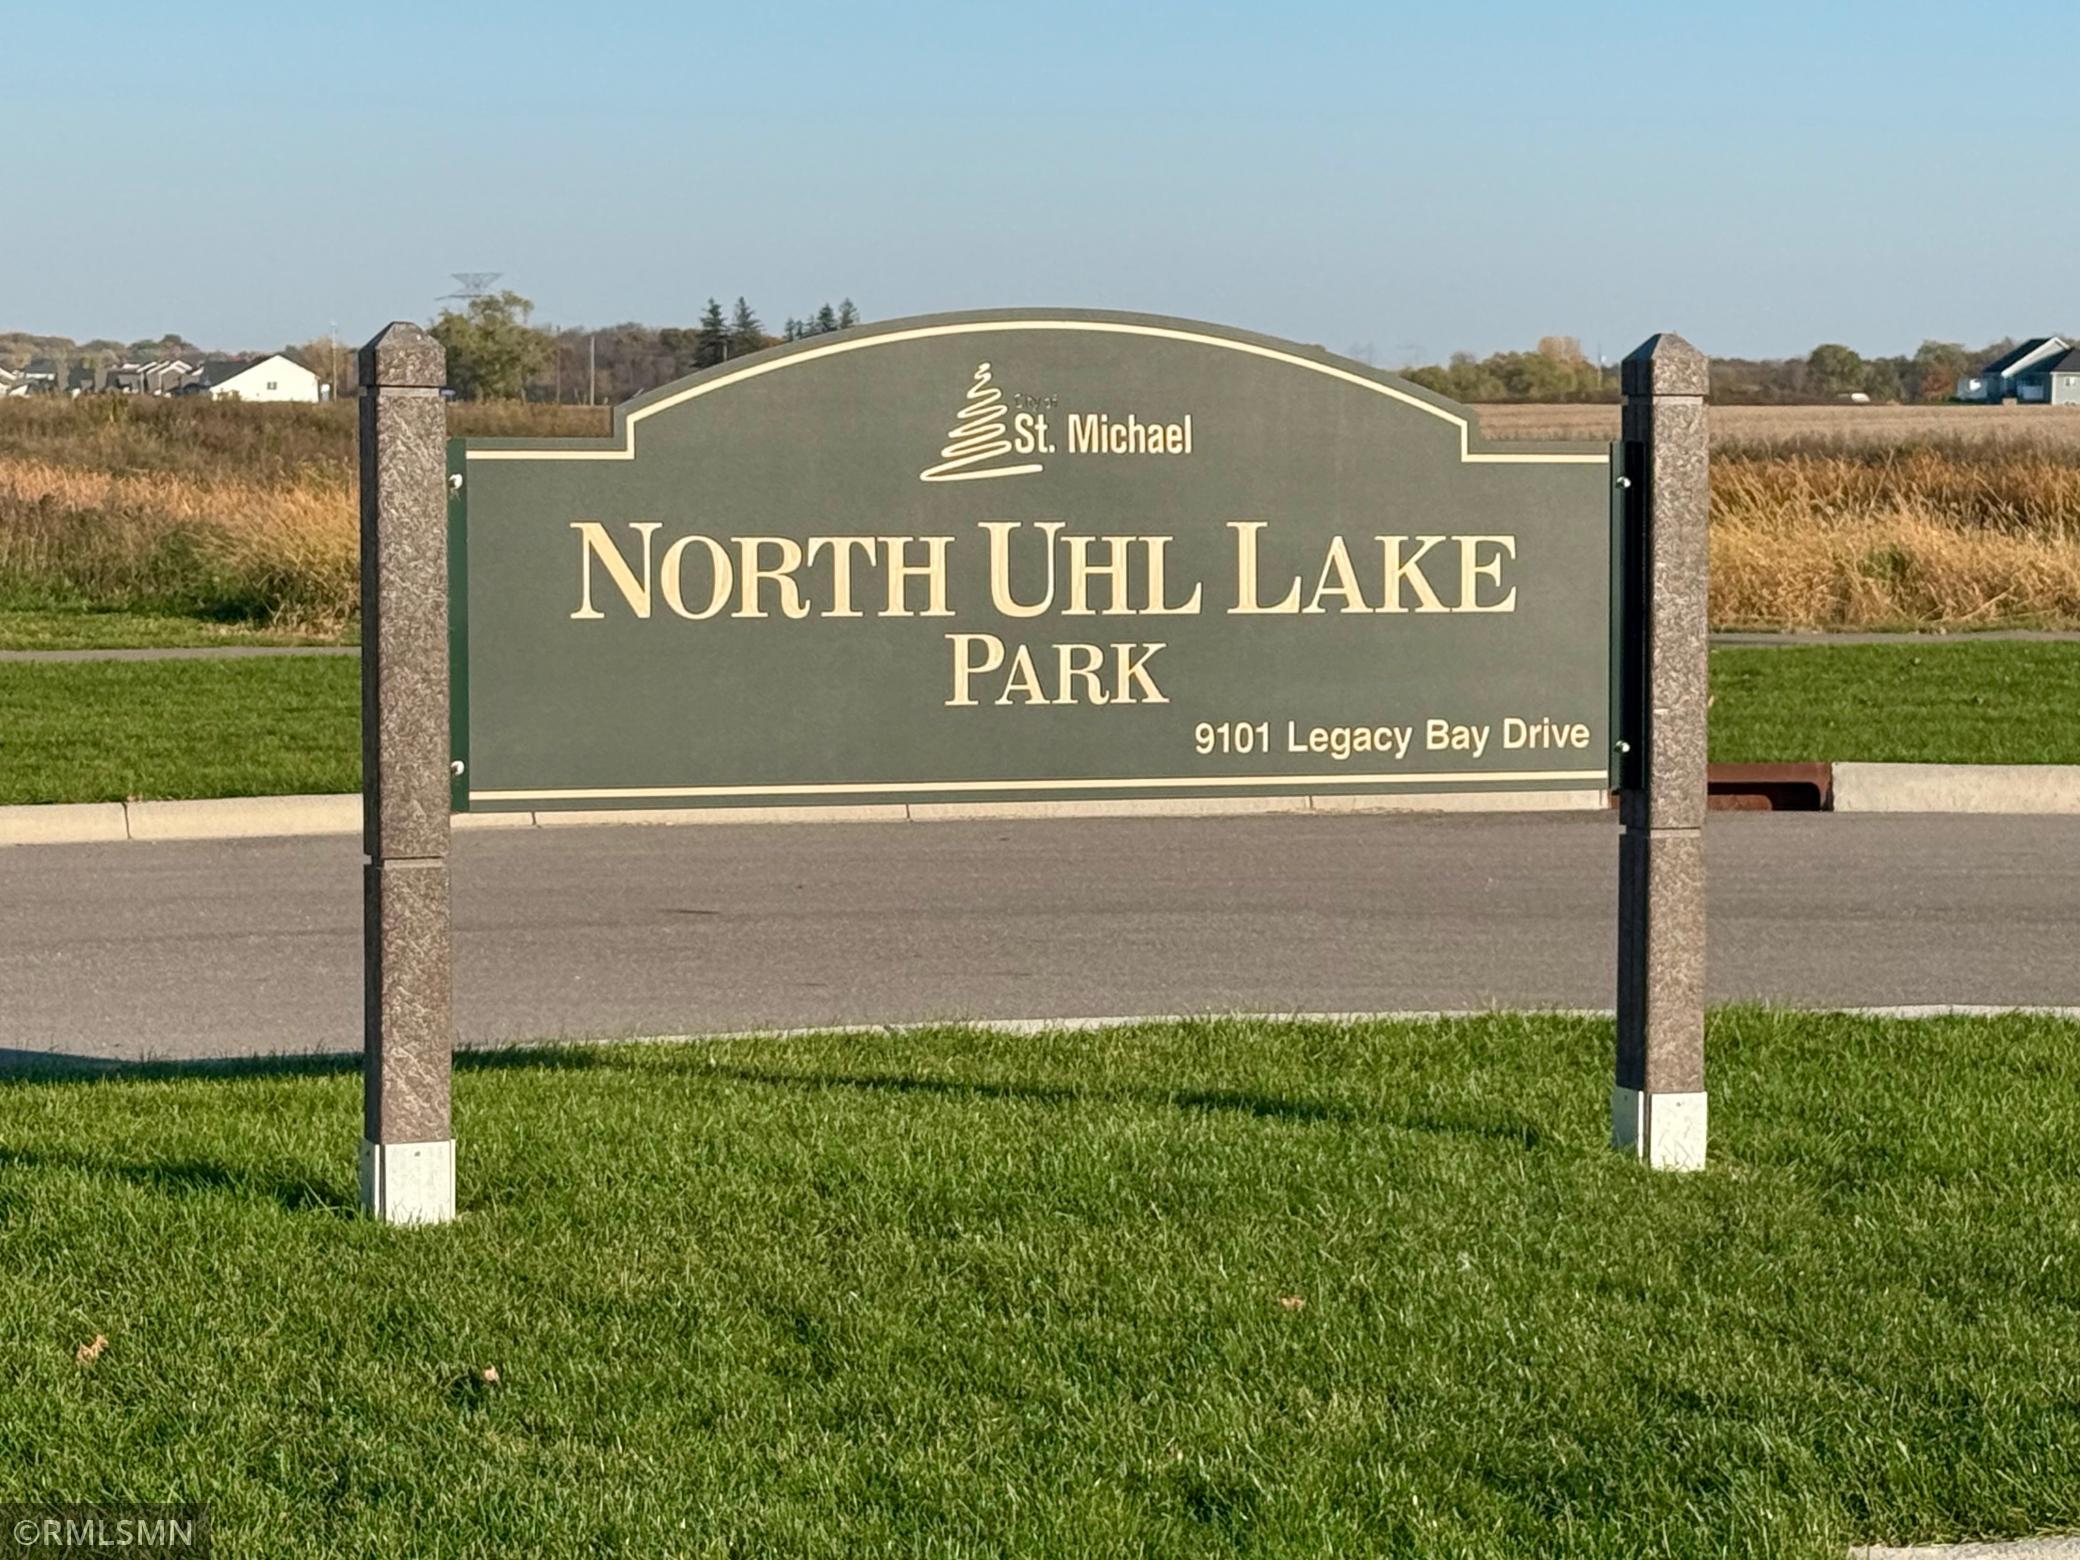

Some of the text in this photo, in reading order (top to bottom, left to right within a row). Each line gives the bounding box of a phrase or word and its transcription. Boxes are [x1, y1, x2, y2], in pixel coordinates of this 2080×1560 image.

[1014, 412, 1192, 454] St. Michael
[569, 521, 1518, 620] NORTH UHL LAKE
[944, 633, 1170, 706] PARK
[1195, 716, 1590, 760] 9101 Legacy Bay Drive
